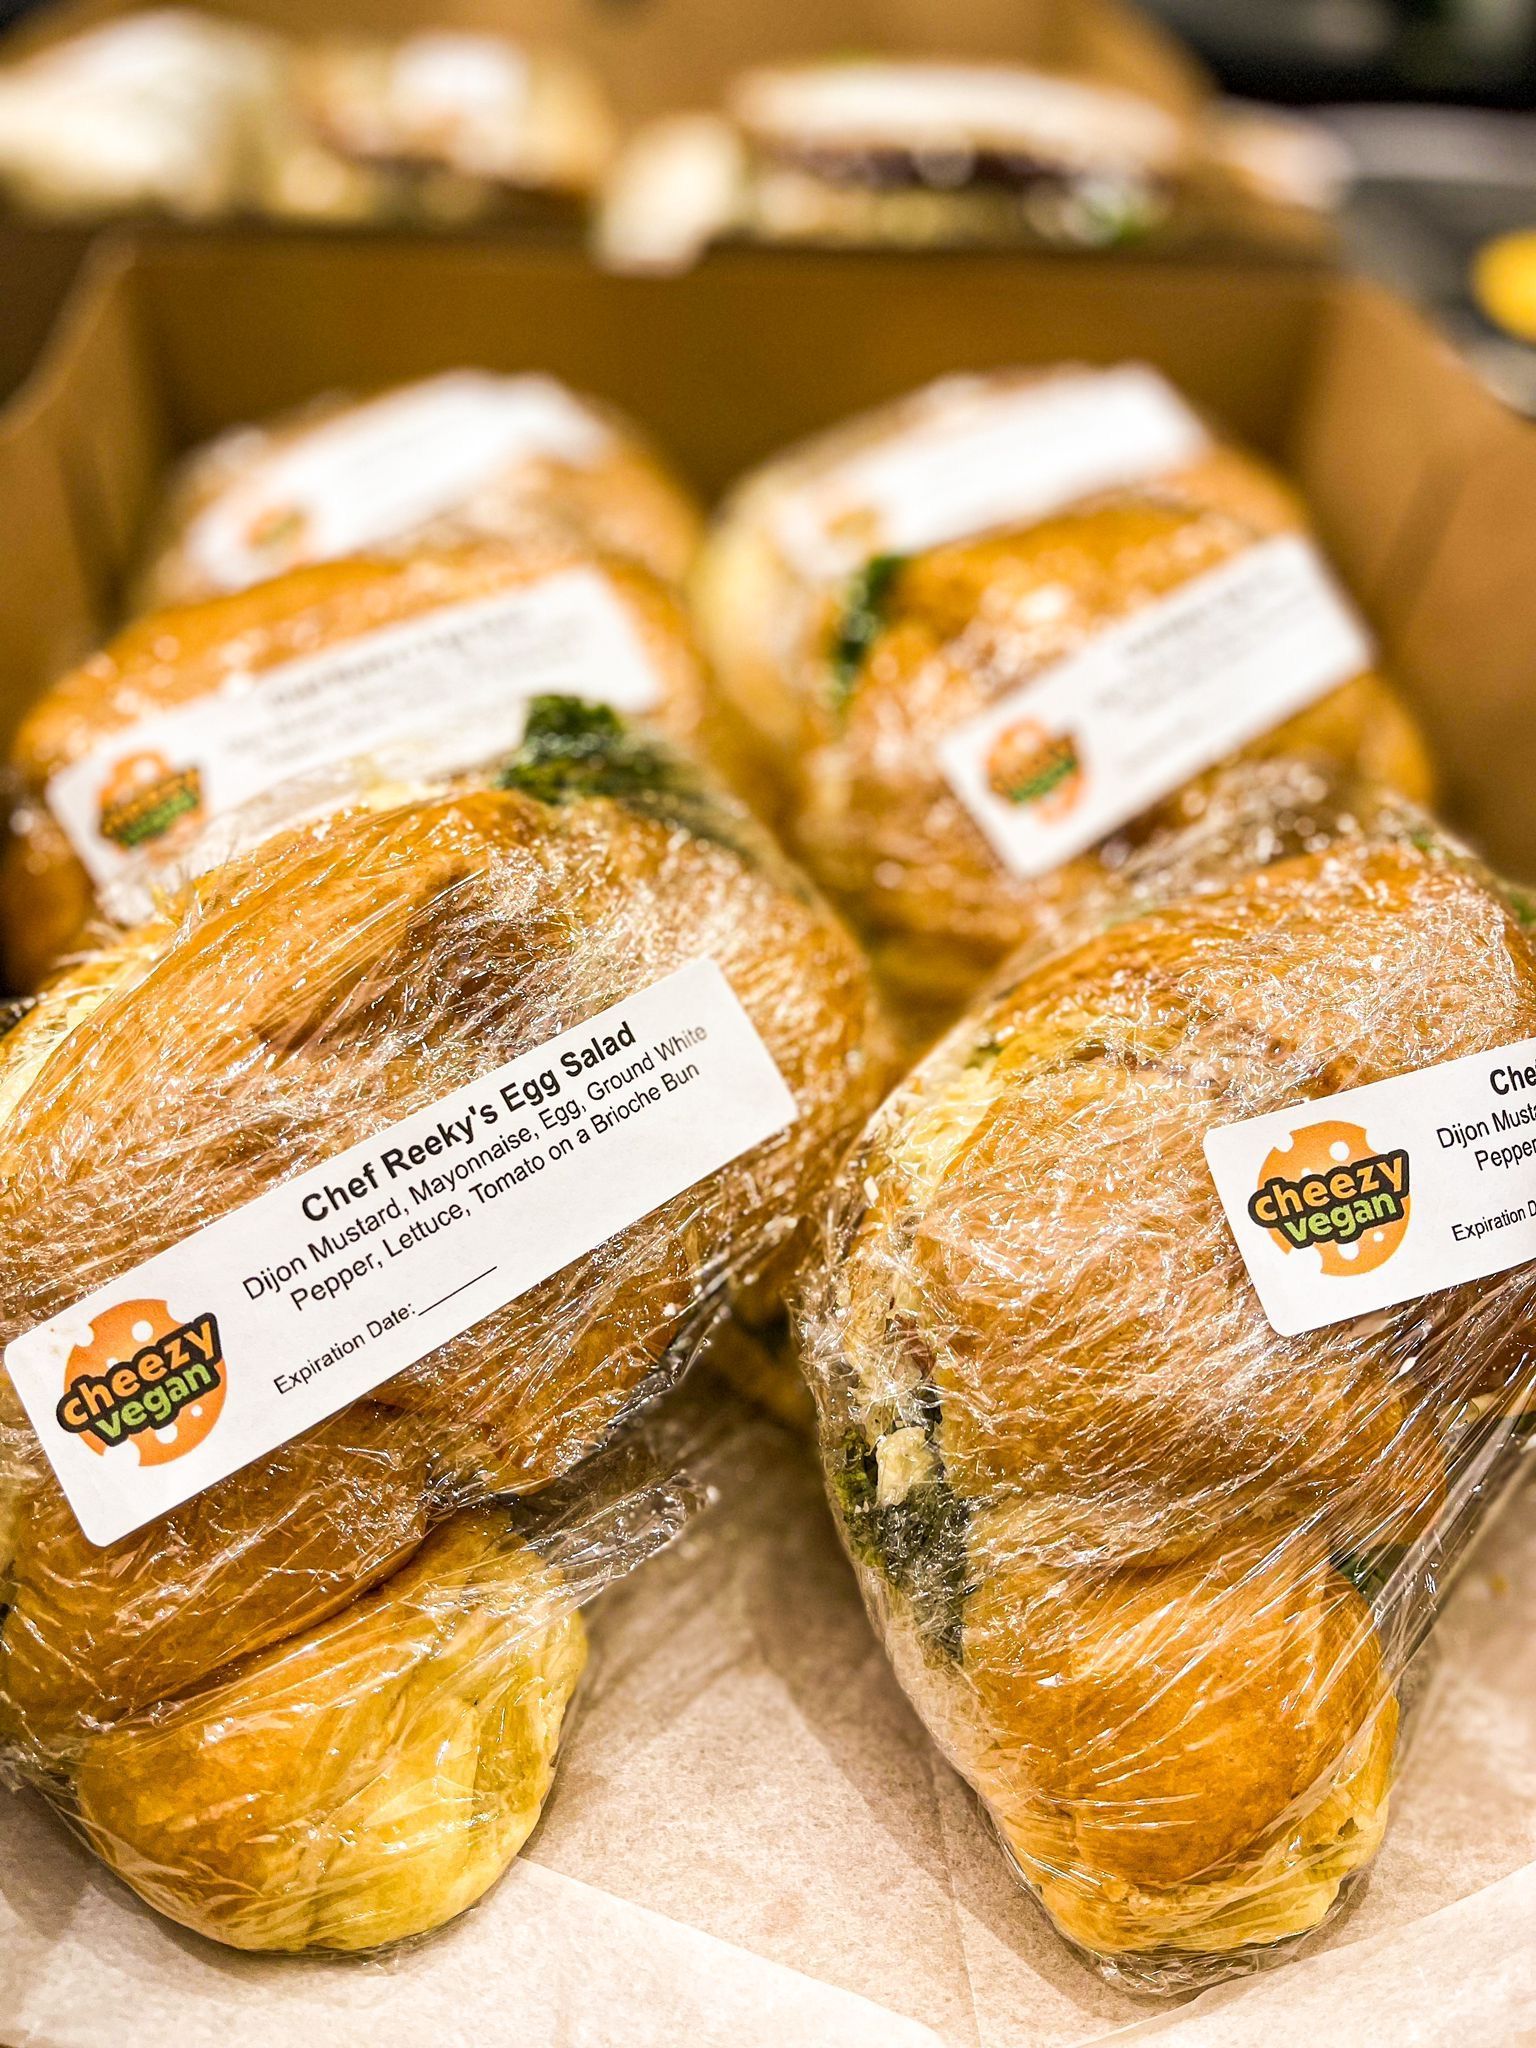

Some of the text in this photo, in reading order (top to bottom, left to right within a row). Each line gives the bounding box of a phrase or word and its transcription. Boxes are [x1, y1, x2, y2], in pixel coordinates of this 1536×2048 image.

[1490, 1058, 1536, 1095] Che
[302, 1021, 637, 1221] Chef Reeky's Egg Salad
[1436, 1103, 1536, 1148] Dijon Must
[241, 1025, 708, 1301] Dijon Mustard, Mayonnaise, Egg, Ground White
[289, 1064, 700, 1312] Pepper, Lettuce, Tomato on a Brioche Bun
[1254, 1155, 1405, 1223] cheezy
[1283, 1191, 1398, 1243] vegan
[1451, 1207, 1527, 1241] Expiration
[60, 1320, 218, 1427] cheezy
[273, 1304, 417, 1395] Expiration Date:
[93, 1361, 214, 1440] vegan
